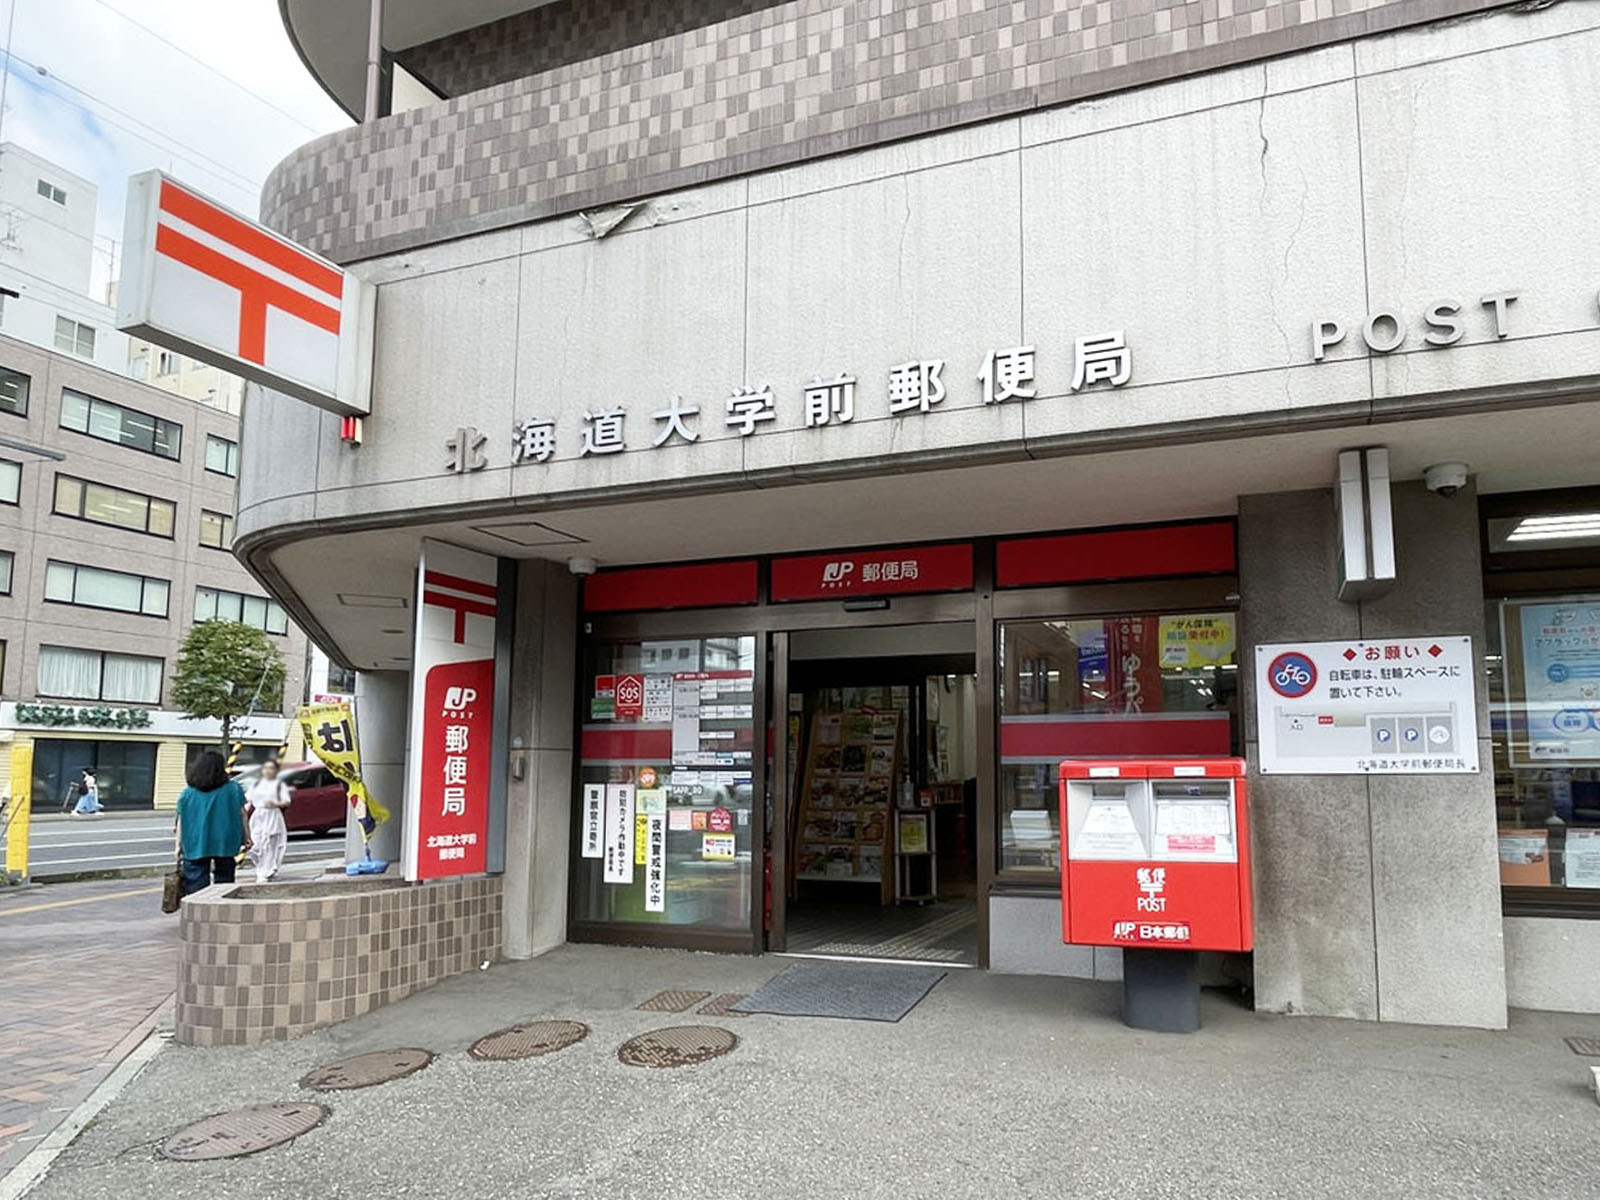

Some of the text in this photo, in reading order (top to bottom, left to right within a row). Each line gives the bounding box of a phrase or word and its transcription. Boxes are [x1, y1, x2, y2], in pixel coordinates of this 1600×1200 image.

[1312, 292, 1518, 361] POST
[445, 329, 1132, 474] 北海道大学前郵便局
[862, 560, 918, 582] 郵便局
[1365, 645, 1420, 661] お願い
[1329, 666, 1461, 682] 自転車は、駐輪スペースに
[619, 687, 639, 701] SOS
[1329, 685, 1403, 699] 置いて下さい。
[442, 725, 469, 816] 郵便局
[1137, 867, 1166, 884] 郵便
[1137, 897, 1166, 912] POST
